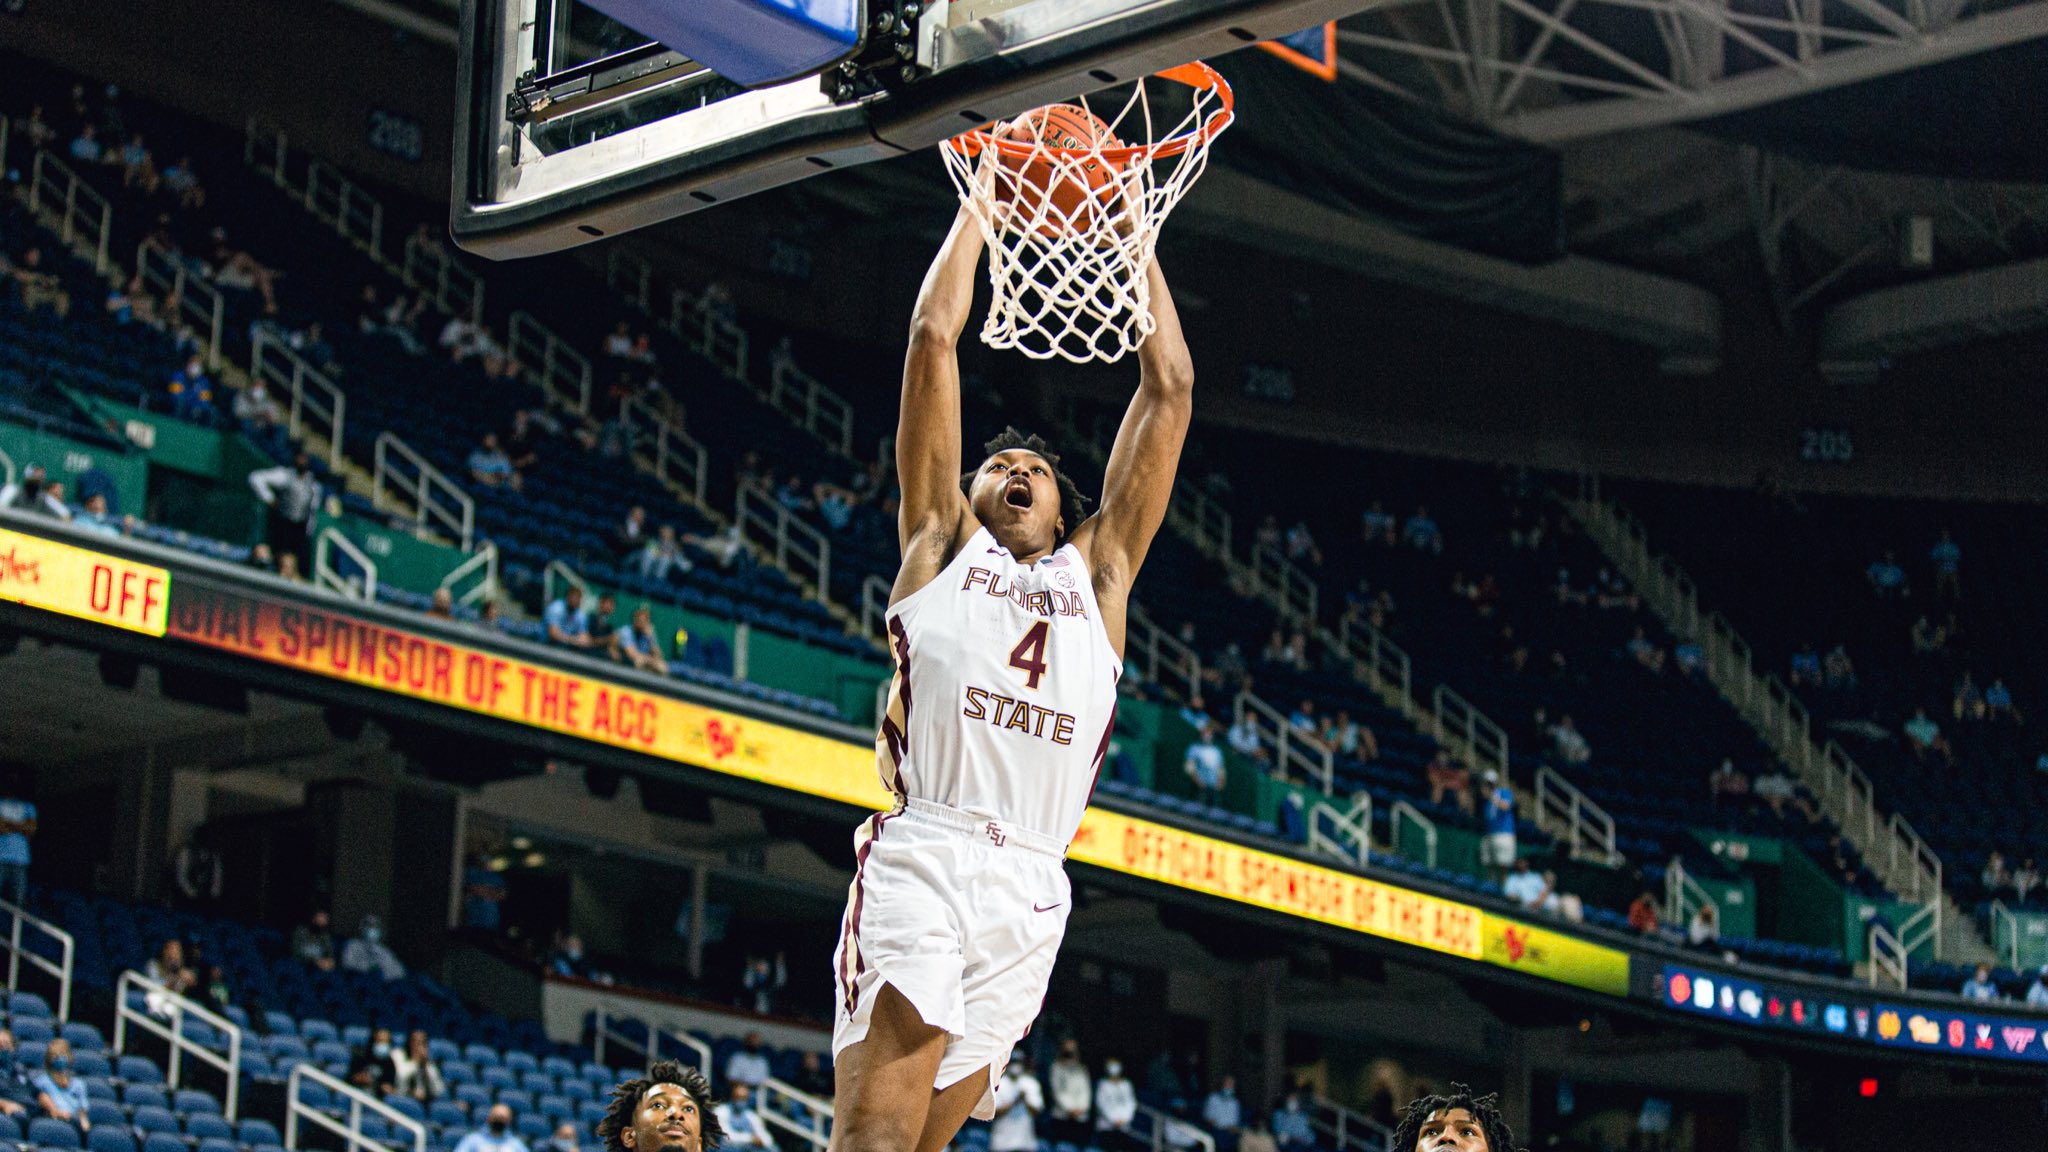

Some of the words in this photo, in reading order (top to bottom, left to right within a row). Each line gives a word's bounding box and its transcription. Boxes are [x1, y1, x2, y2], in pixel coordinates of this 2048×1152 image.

[1801, 430, 1853, 463] 205
[91, 564, 161, 623] OFF
[961, 566, 1088, 620] FLORIDA
[278, 604, 452, 695] SPONSOR
[465, 651, 508, 710] OF
[517, 665, 581, 728] THE
[592, 687, 658, 745] ACC
[1008, 618, 1051, 692] 4
[963, 685, 1076, 745] STATE
[985, 821, 1006, 847] FSU
[1122, 822, 1229, 891] OFFICIAL
[1241, 856, 1346, 920] SPONSOR
[1352, 885, 1376, 931] OF
[1387, 895, 1424, 944] THE
[1431, 908, 1474, 951] ACC
